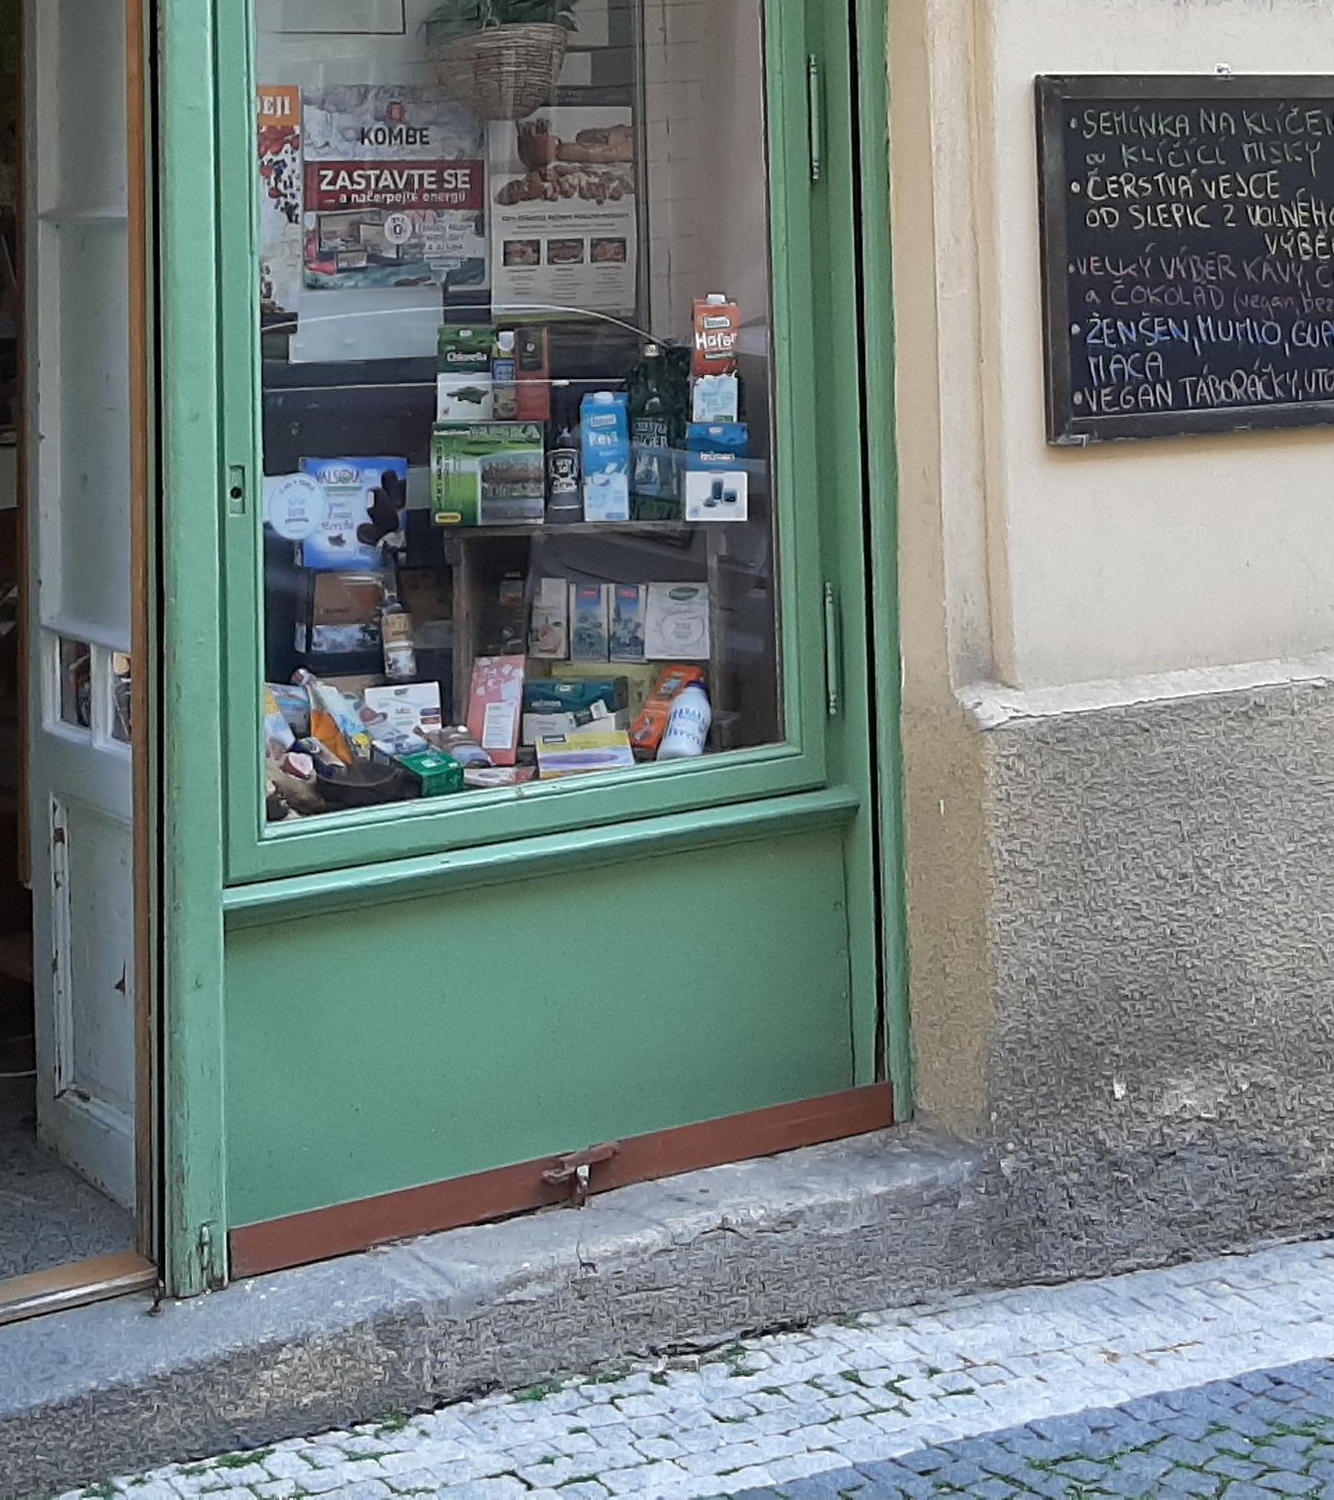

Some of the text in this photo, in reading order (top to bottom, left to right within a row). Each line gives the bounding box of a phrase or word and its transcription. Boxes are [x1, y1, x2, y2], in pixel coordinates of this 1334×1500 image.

[1083, 106, 1190, 139] SEMÍNKA
[1200, 108, 1236, 136] NA
[1242, 141, 1322, 178] MISKY
[319, 169, 471, 190] ZASTAVTE SE
[1086, 167, 1280, 201] ČERSTVÁ VEJCE
[1085, 207, 1120, 228] OD
[1128, 203, 1212, 230] SLEPIC
[1085, 289, 1101, 304] a
[1088, 351, 1165, 387] MACA
[1084, 380, 1173, 412] VEGAN
